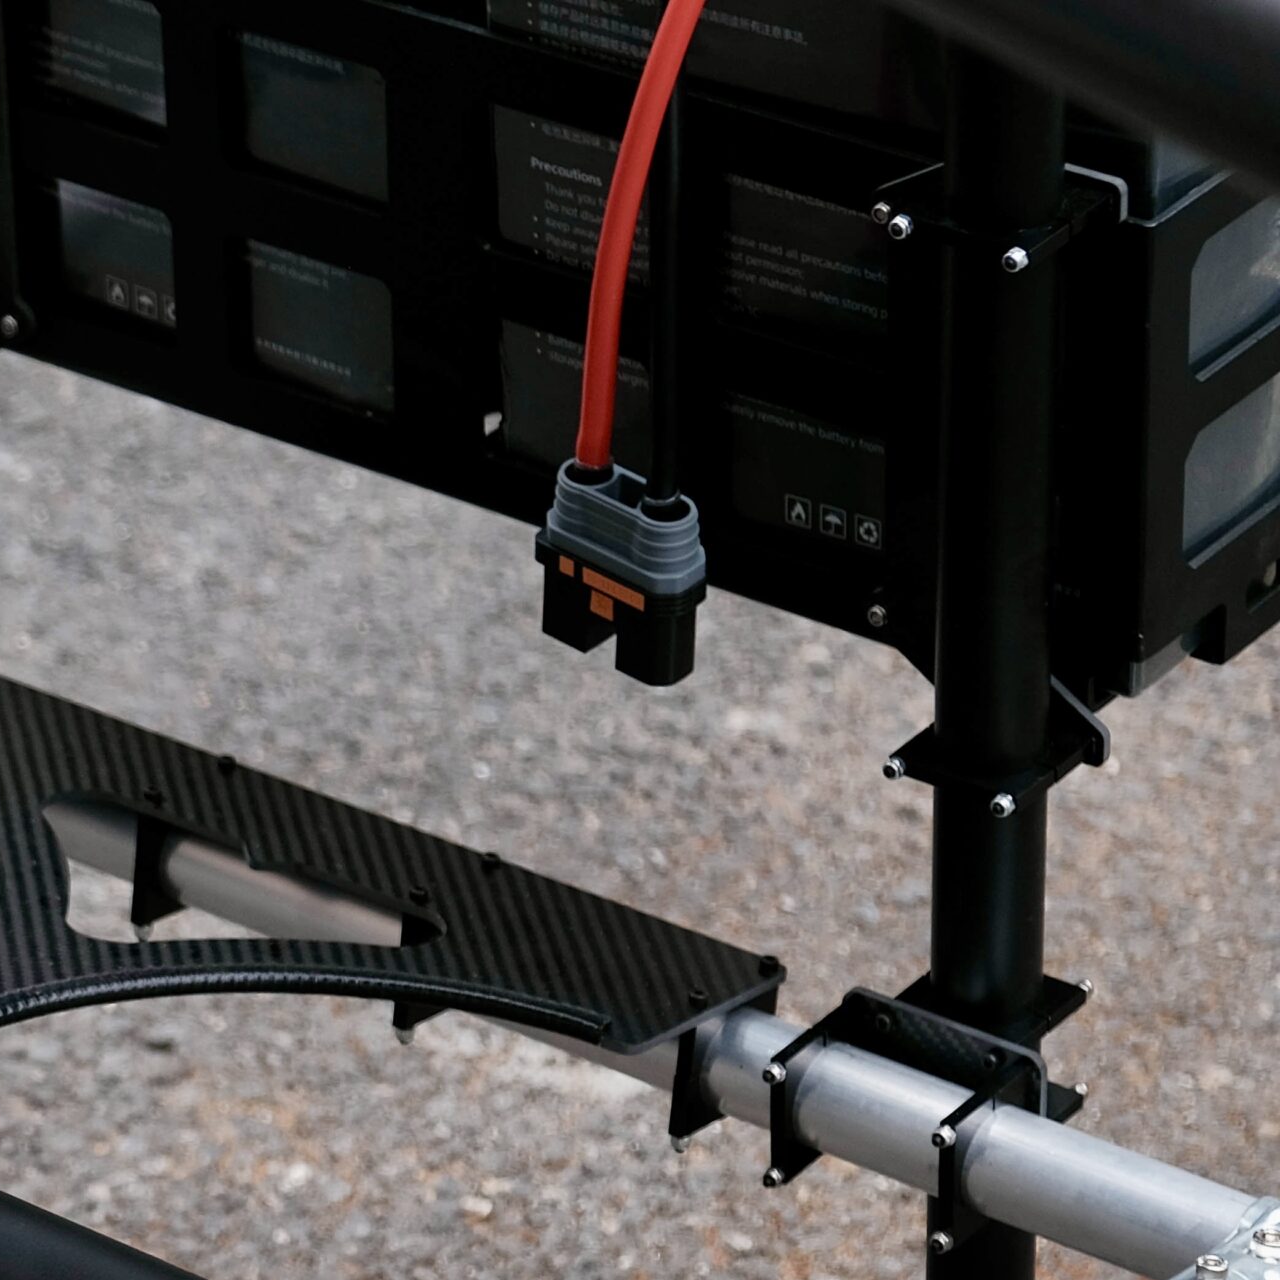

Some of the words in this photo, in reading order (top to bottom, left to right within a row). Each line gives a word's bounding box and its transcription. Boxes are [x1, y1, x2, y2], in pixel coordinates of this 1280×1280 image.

[530, 155, 603, 187] Precautions
[800, 252, 862, 278] precautions
[756, 411, 798, 432] remove
[798, 421, 816, 437] the
[817, 427, 858, 449] battery
